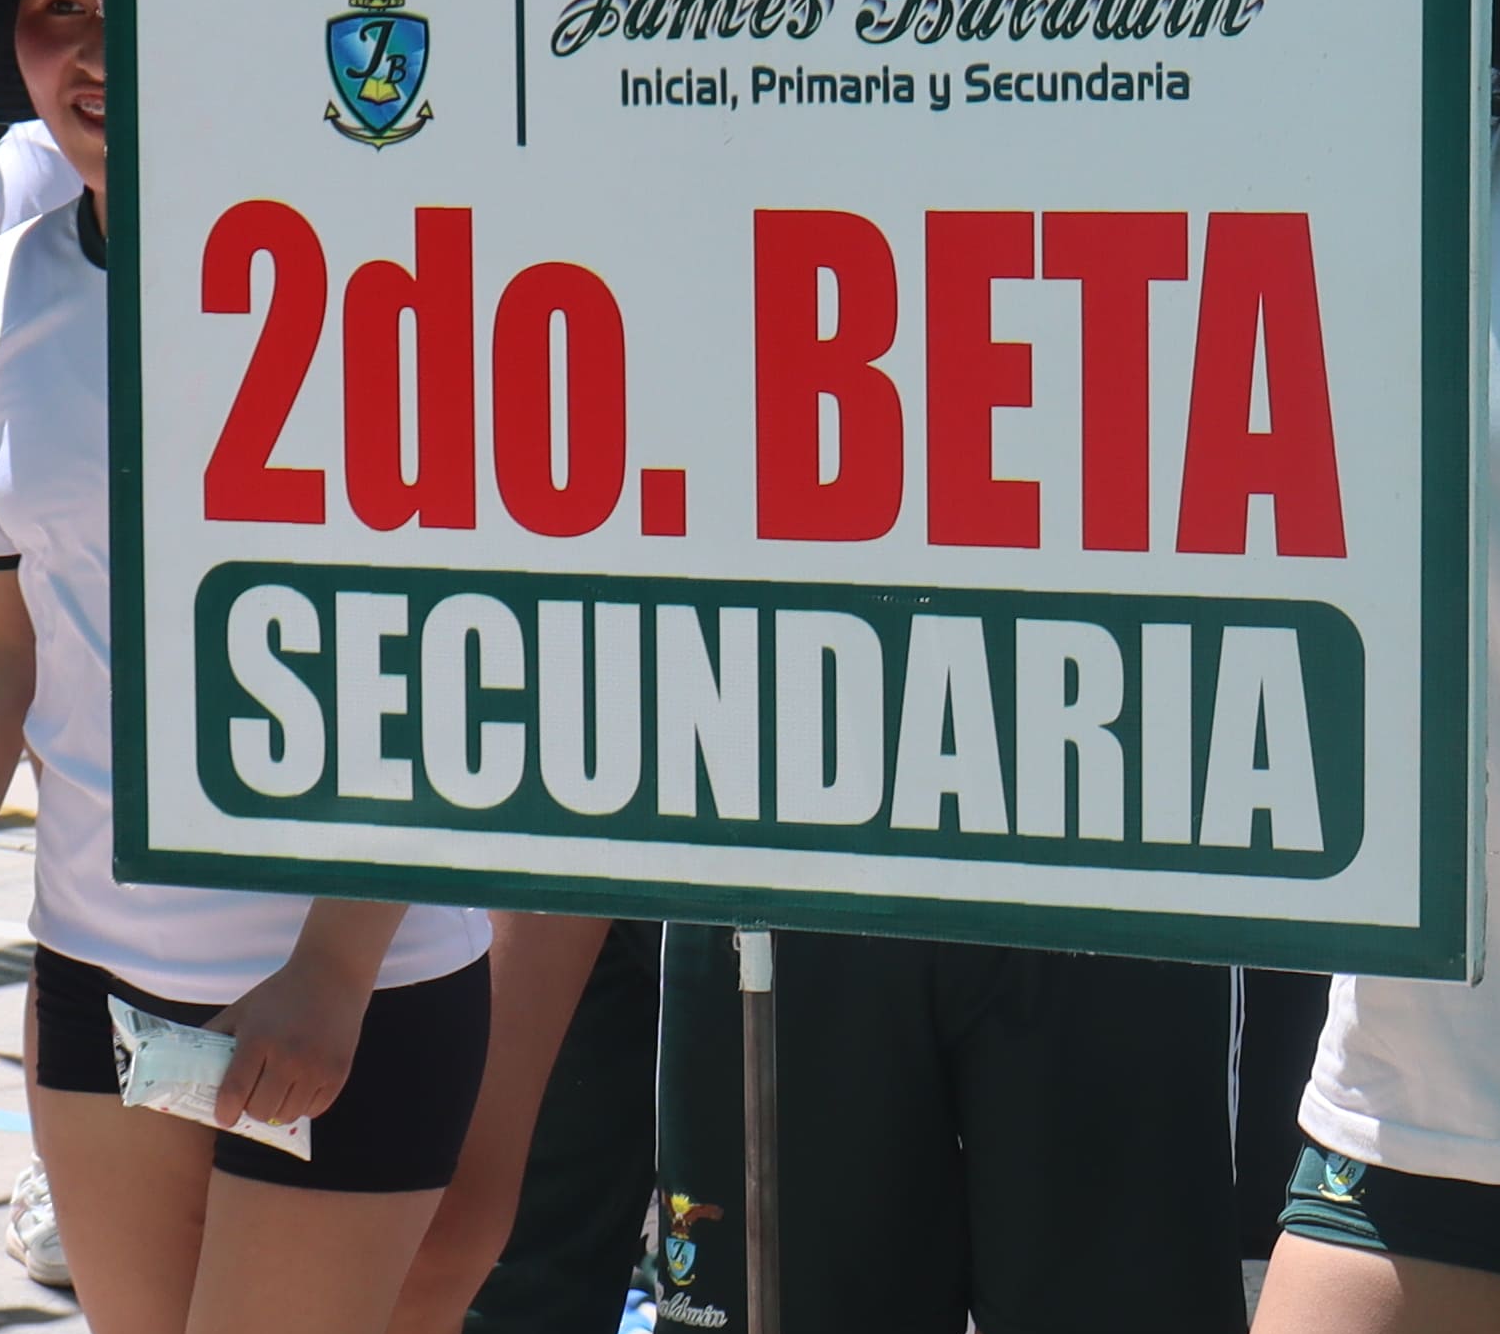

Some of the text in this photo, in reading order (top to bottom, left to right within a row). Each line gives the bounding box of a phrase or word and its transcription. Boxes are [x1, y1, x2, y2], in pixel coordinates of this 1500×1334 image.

[620, 62, 1192, 112] Inicial, Primaria y Secundaria
[200, 199, 1348, 560] 2do. BETA
[226, 583, 1325, 852] SECUNDARIA
